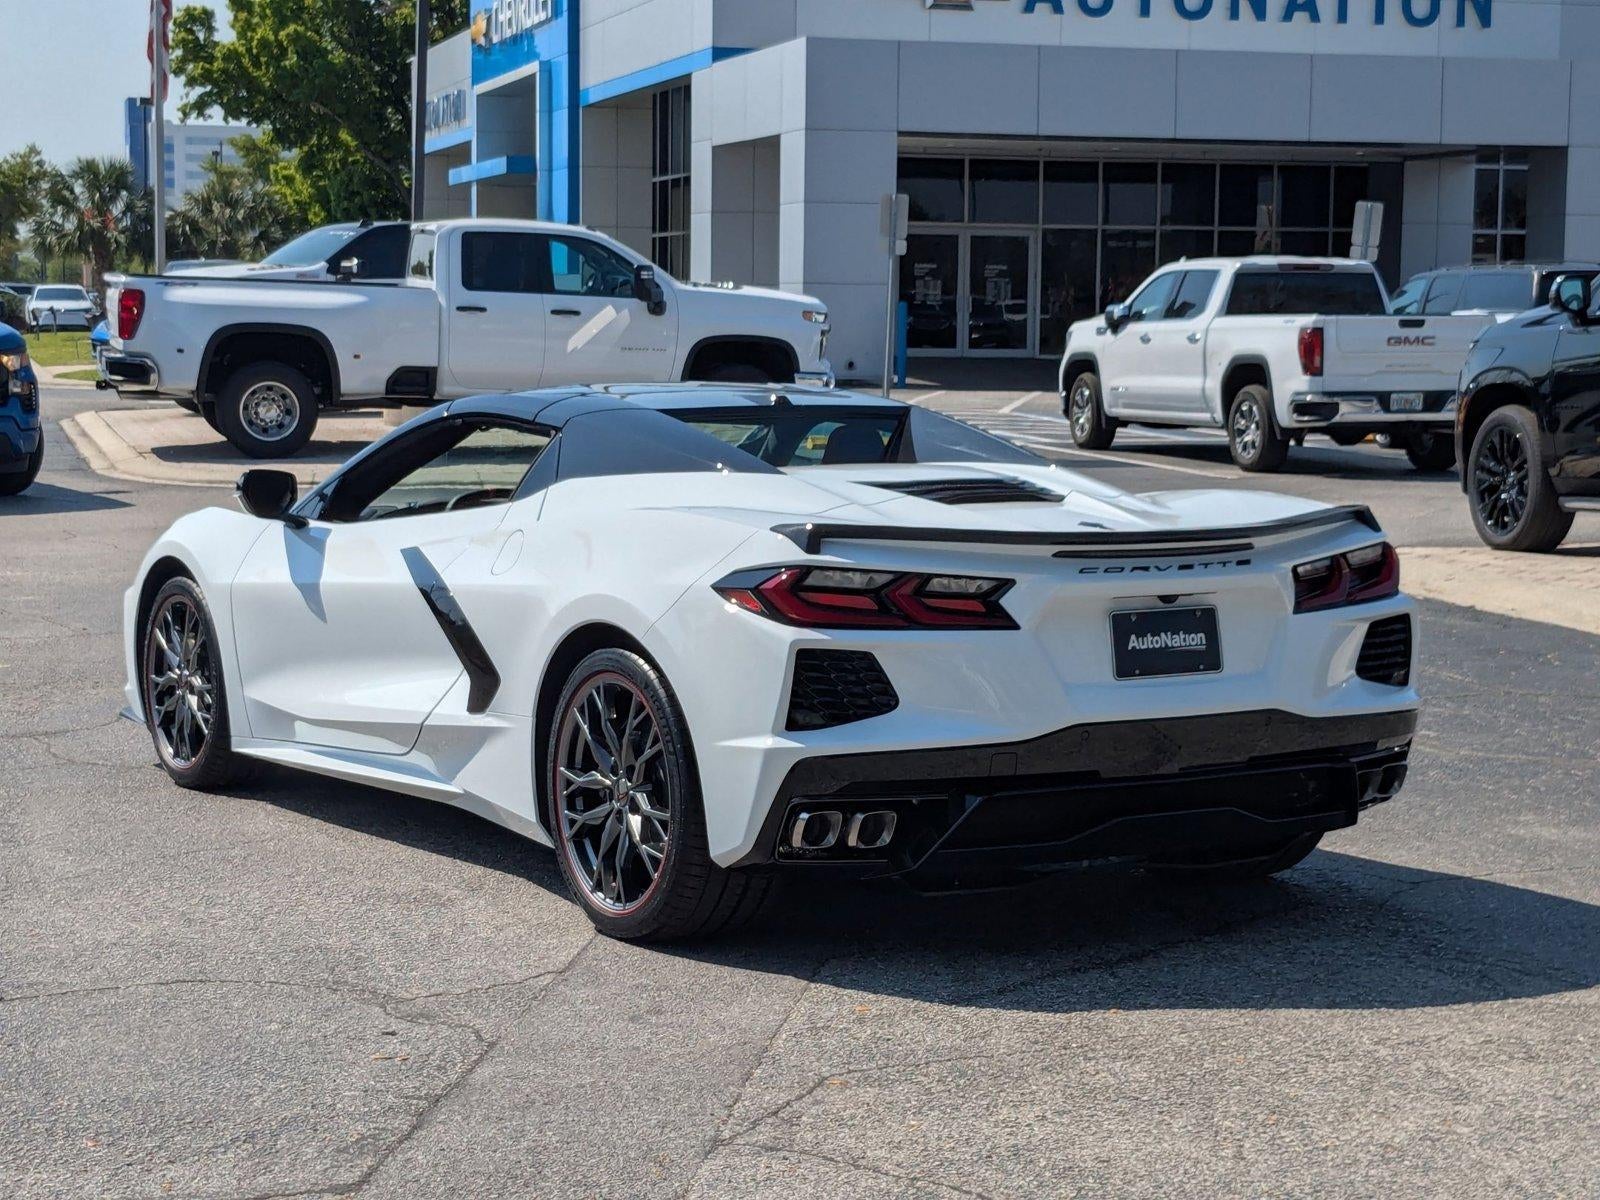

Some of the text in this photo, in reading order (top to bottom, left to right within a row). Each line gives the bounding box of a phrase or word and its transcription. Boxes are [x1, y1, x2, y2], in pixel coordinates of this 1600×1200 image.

[1386, 336, 1436, 347] GMC
[1078, 558, 1252, 575] CORVETTE
[1127, 630, 1207, 650] AutoNation
